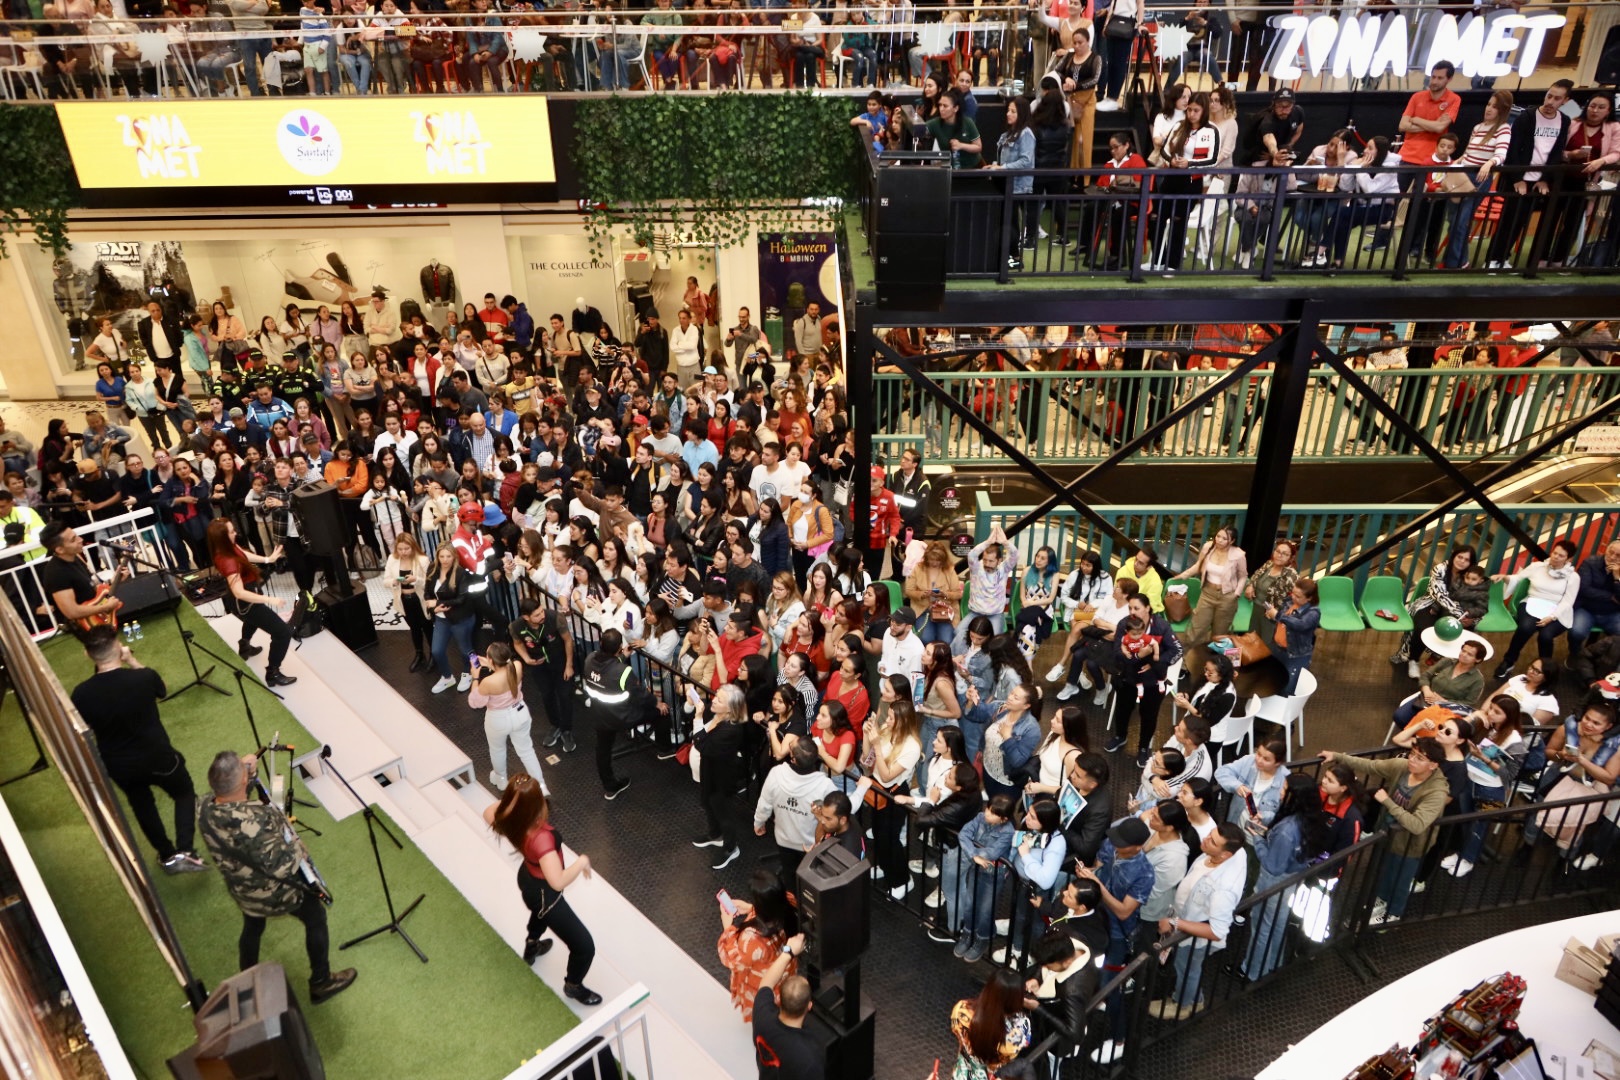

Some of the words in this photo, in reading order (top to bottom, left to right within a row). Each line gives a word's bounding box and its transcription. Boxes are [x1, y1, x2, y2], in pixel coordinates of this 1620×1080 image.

[1270, 13, 1410, 80] ZONA
[1425, 9, 1567, 78] MET
[136, 145, 203, 179] MET
[425, 141, 492, 175] MET
[107, 242, 140, 256] ADT
[779, 254, 815, 263] BAMBINO
[529, 262, 547, 271] THE
[550, 261, 613, 271] COLLECTION
